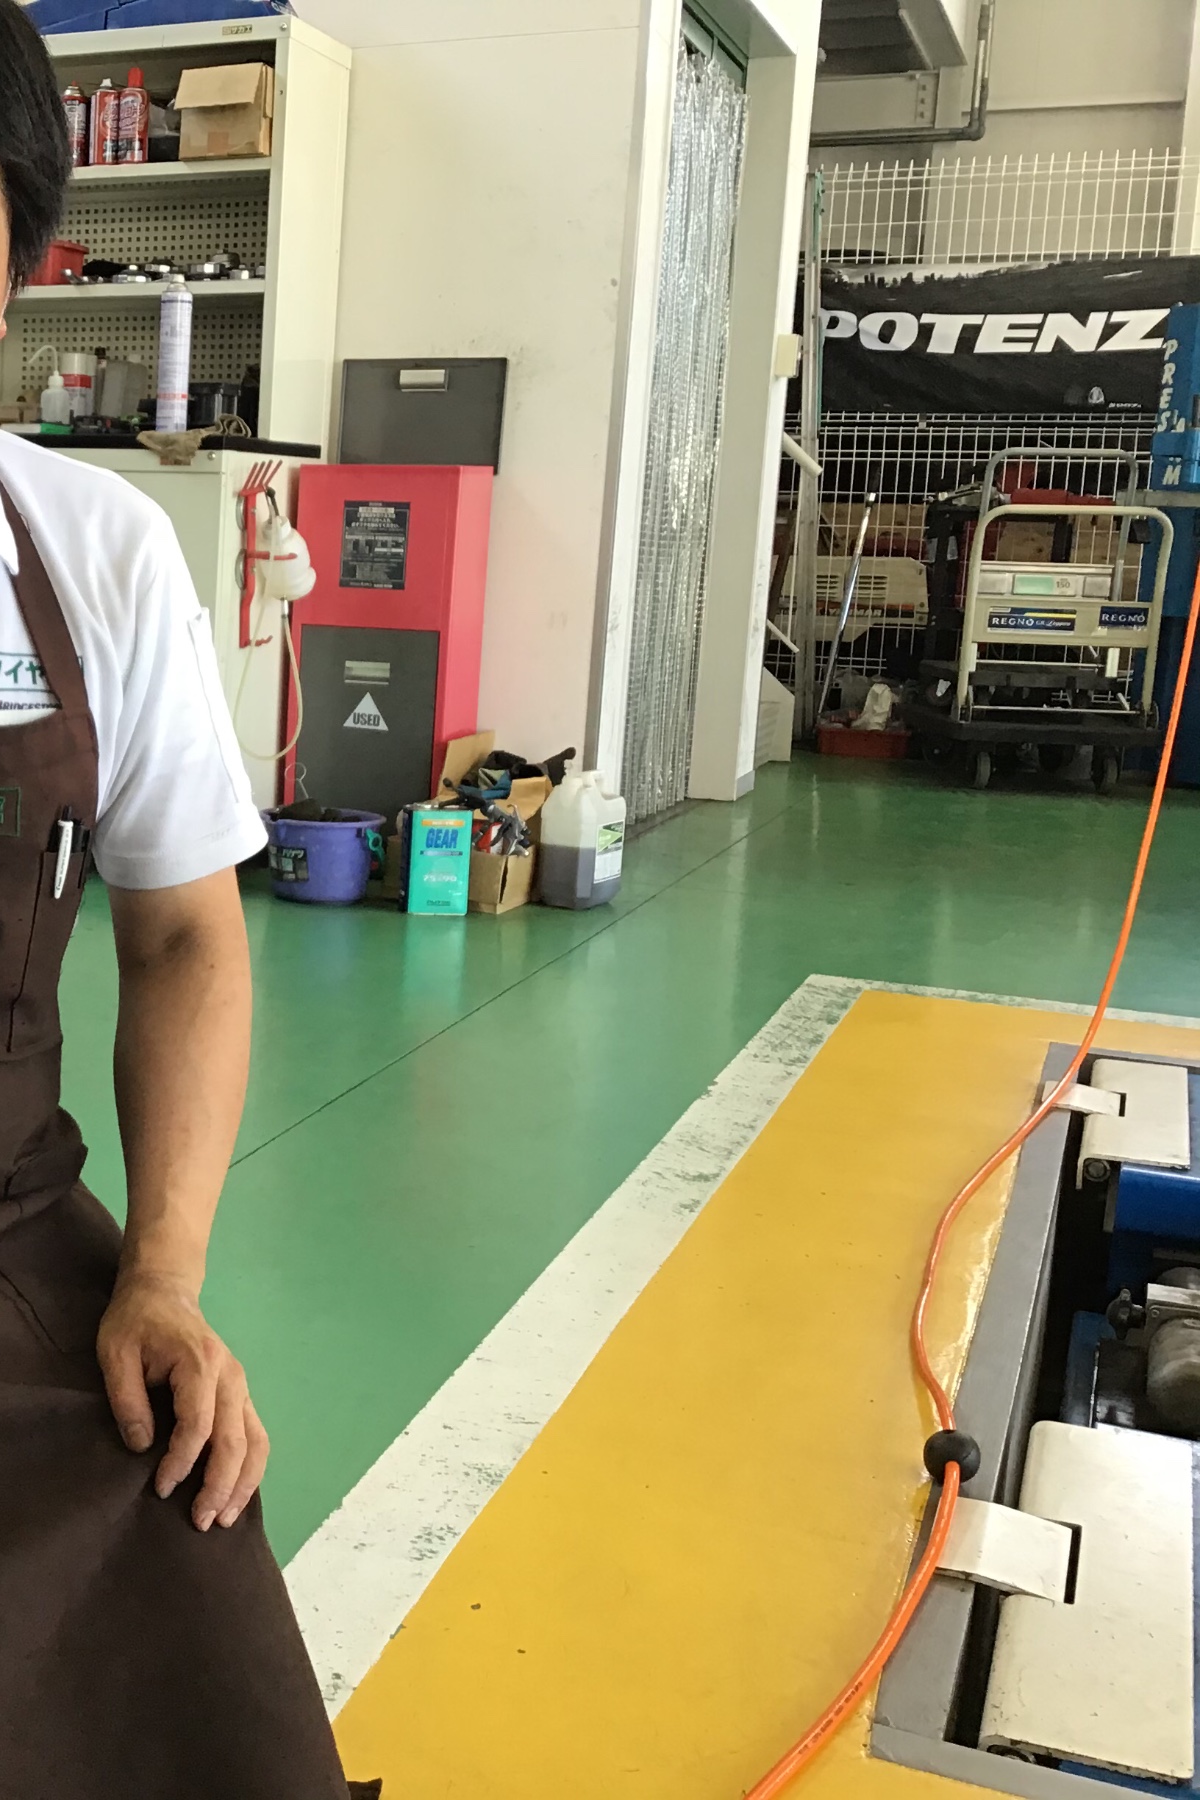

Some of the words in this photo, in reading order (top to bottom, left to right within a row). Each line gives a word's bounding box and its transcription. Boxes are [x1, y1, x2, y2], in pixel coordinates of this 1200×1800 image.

[829, 608, 883, 616] YMAR
[1101, 612, 1146, 623] REGNO
[992, 617, 1035, 626] REGNO
[352, 712, 381, 727] USED
[425, 827, 459, 849] GEAR
